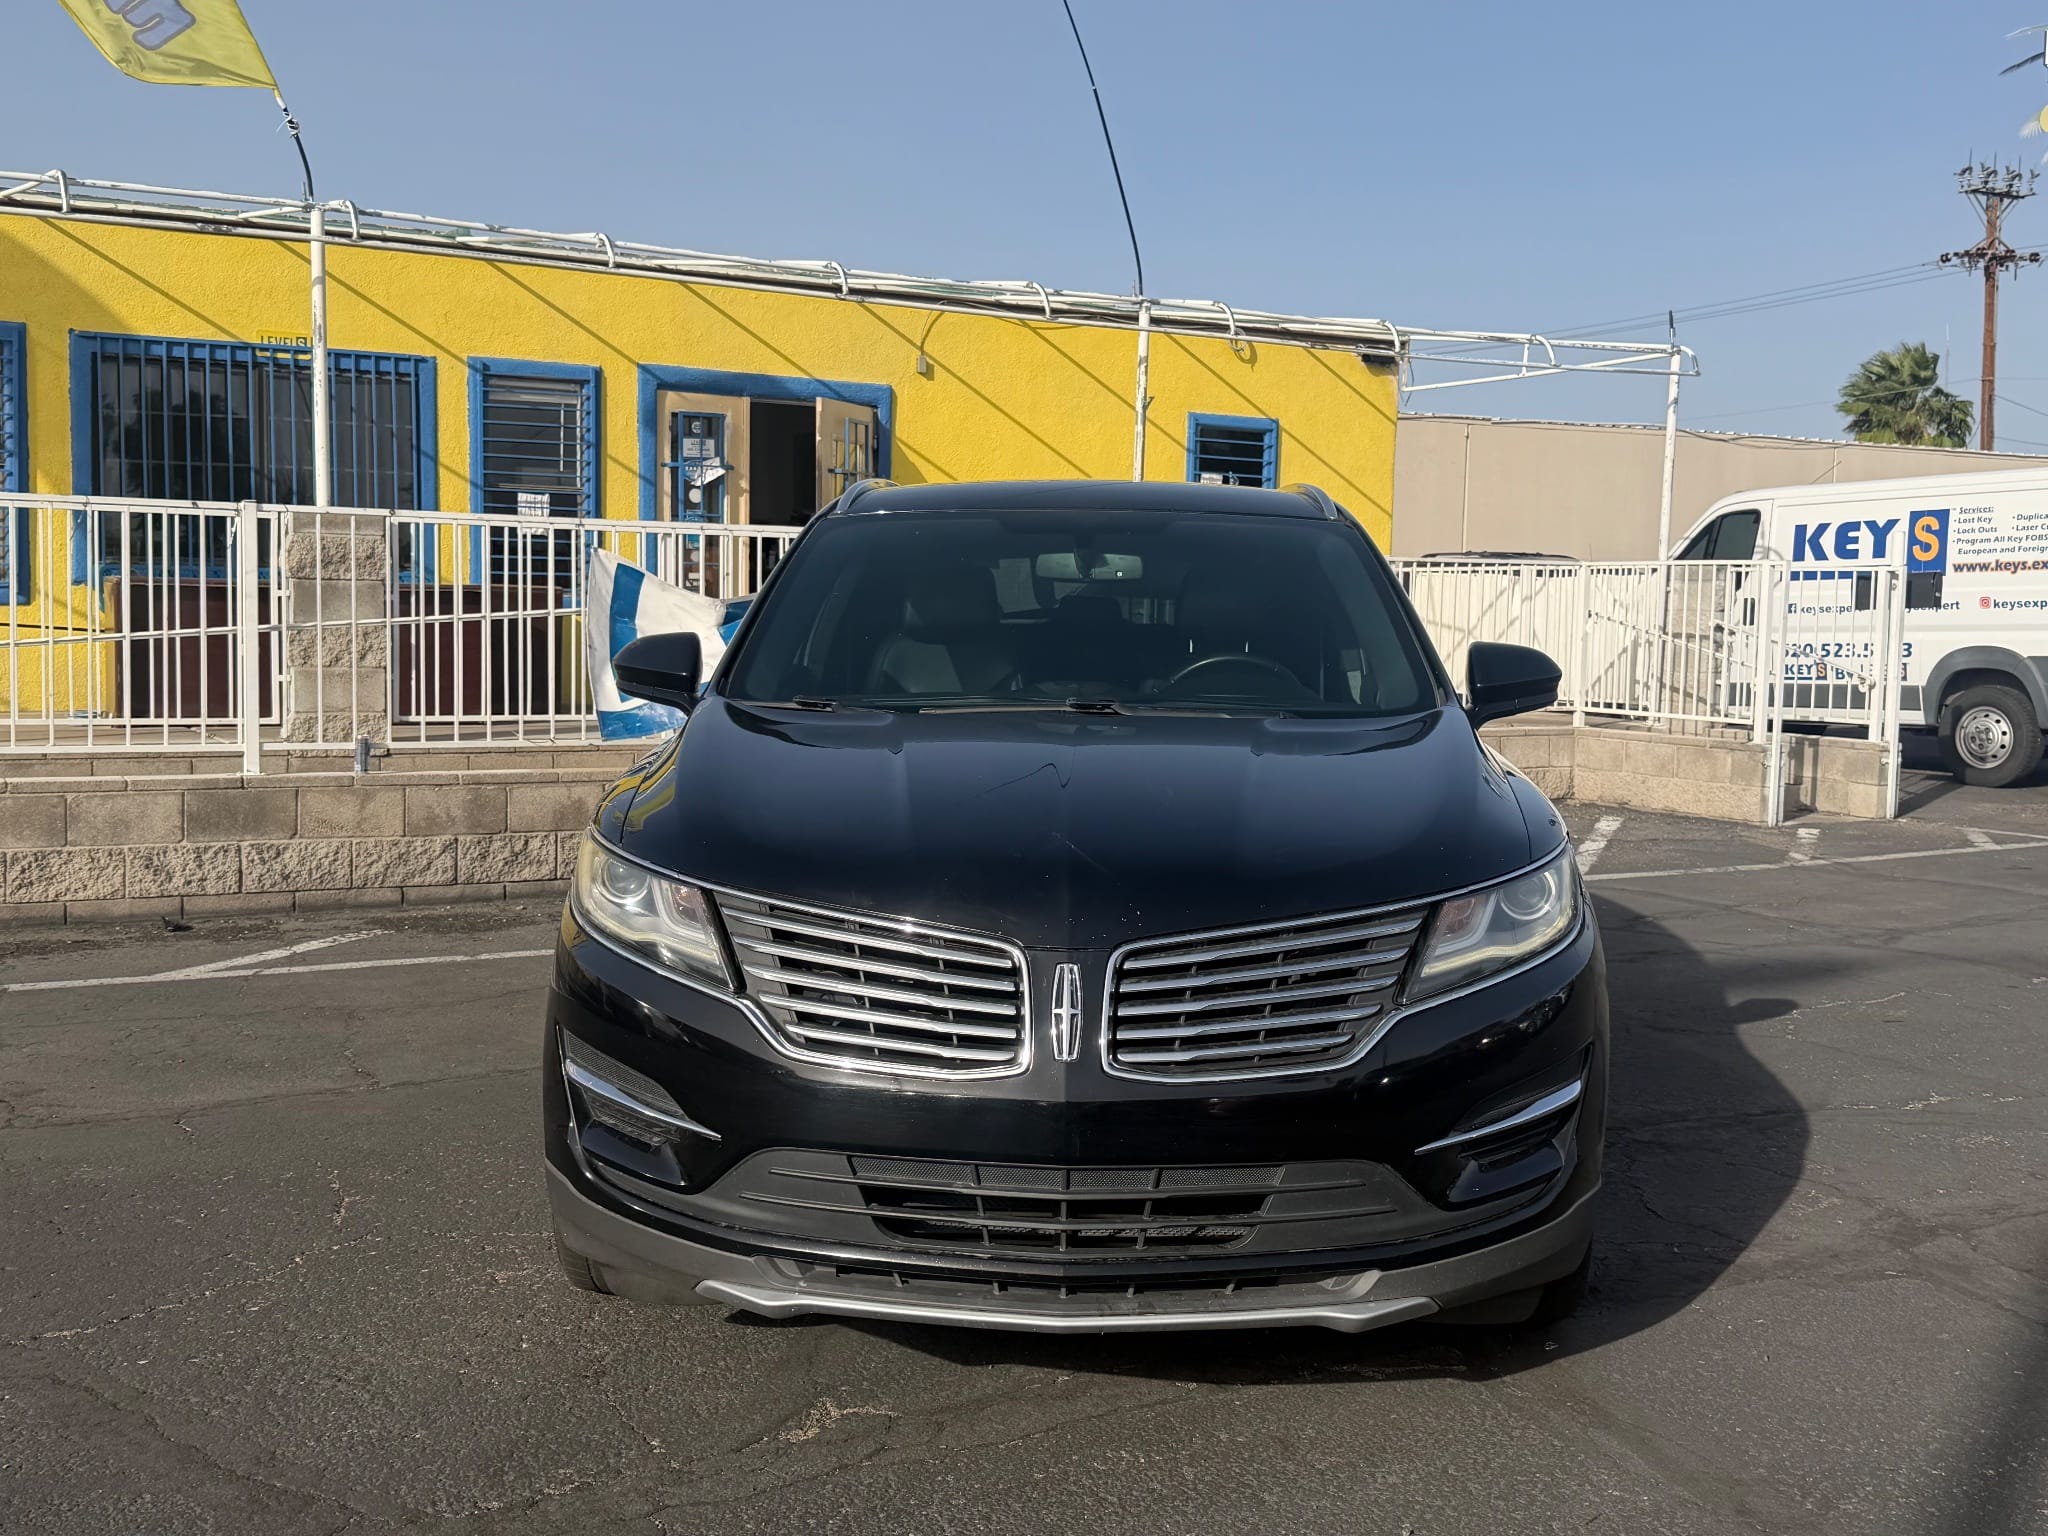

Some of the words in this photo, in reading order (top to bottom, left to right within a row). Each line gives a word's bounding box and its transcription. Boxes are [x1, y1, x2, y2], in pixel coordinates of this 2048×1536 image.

[1977, 516, 1993, 524] Key
[1956, 538, 1991, 546] Program
[2007, 535, 2023, 543] Key
[1958, 547, 1998, 555] European
